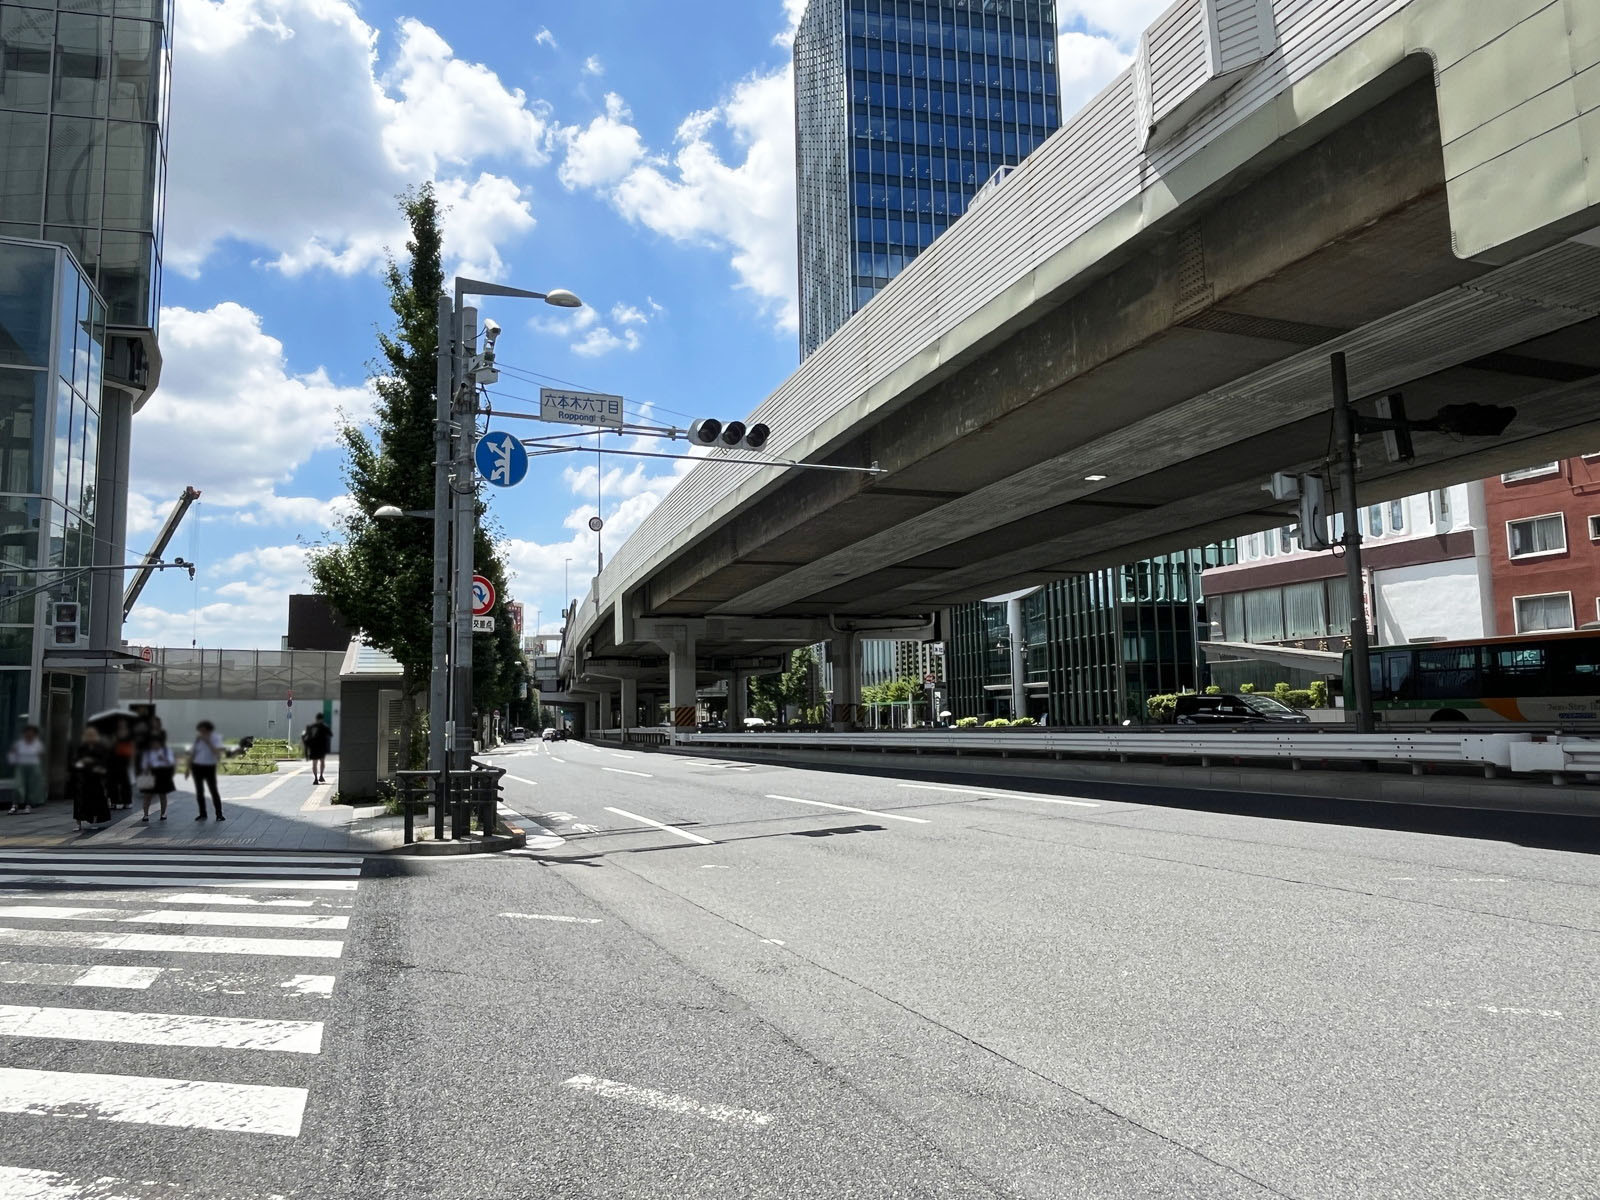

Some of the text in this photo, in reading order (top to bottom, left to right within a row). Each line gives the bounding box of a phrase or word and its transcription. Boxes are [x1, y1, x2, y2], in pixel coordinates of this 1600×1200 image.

[544, 393, 619, 414] 六本木六丁目
[558, 410, 606, 423] Roppongi 6
